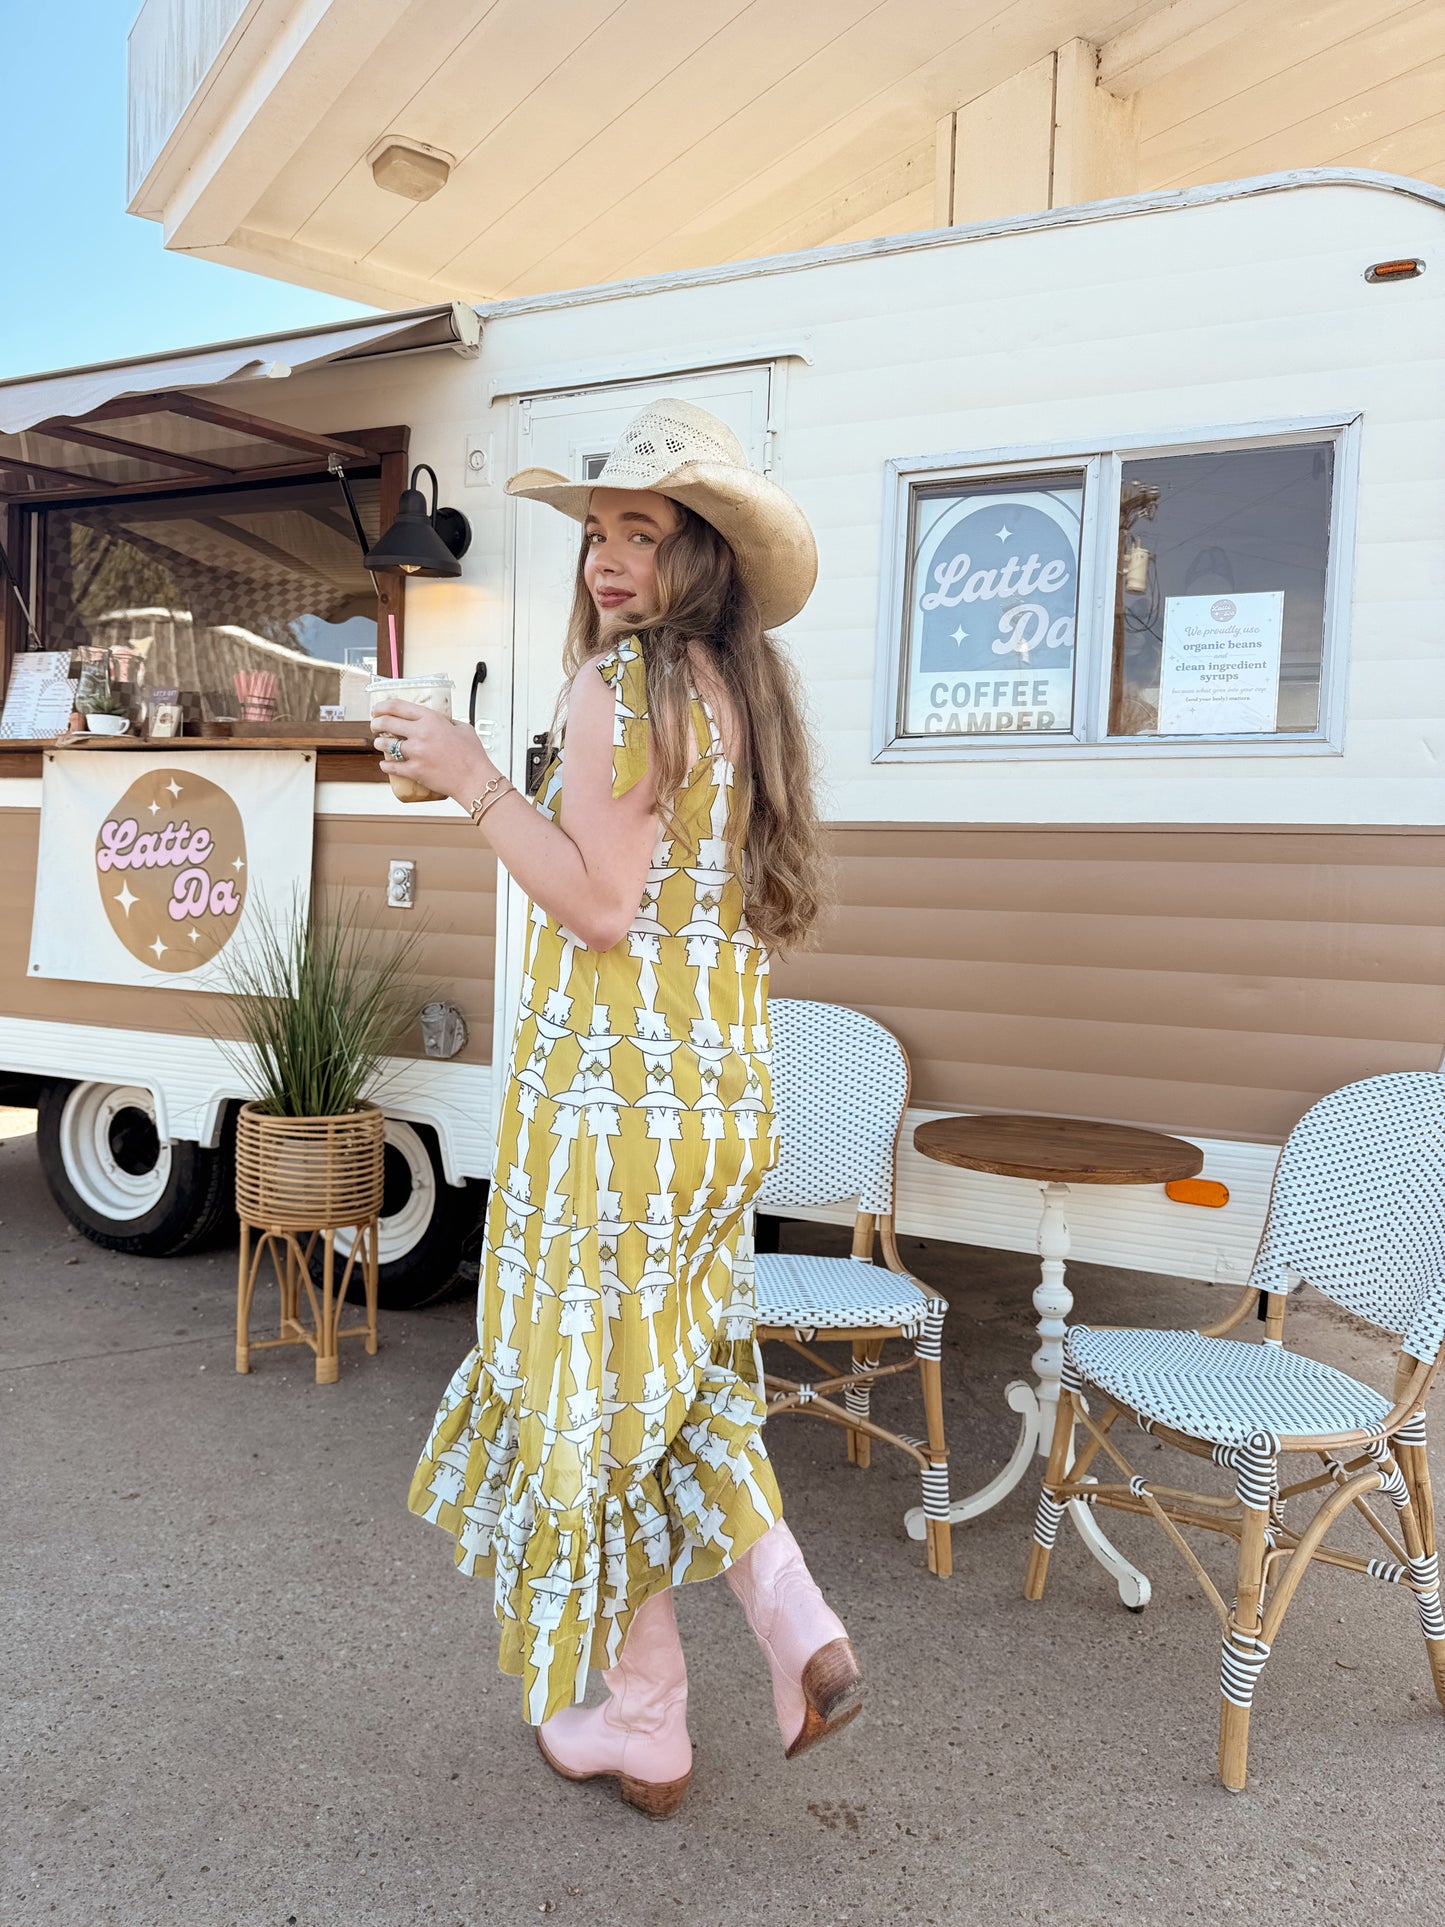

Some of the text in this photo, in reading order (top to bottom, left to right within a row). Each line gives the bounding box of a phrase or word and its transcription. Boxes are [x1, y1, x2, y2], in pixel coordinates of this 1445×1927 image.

[921, 553, 1070, 610] Latte
[992, 604, 1075, 655] Da
[1184, 626, 1202, 637] We
[1203, 625, 1240, 637] proudly
[1183, 640, 1262, 652] organic beans
[1175, 660, 1267, 672] clean ingredient
[1199, 673, 1239, 683] syrups
[930, 680, 1049, 708] COFFEE
[924, 711, 1055, 733] CAMPER
[97, 818, 214, 872] Latte
[168, 867, 240, 921] Da
